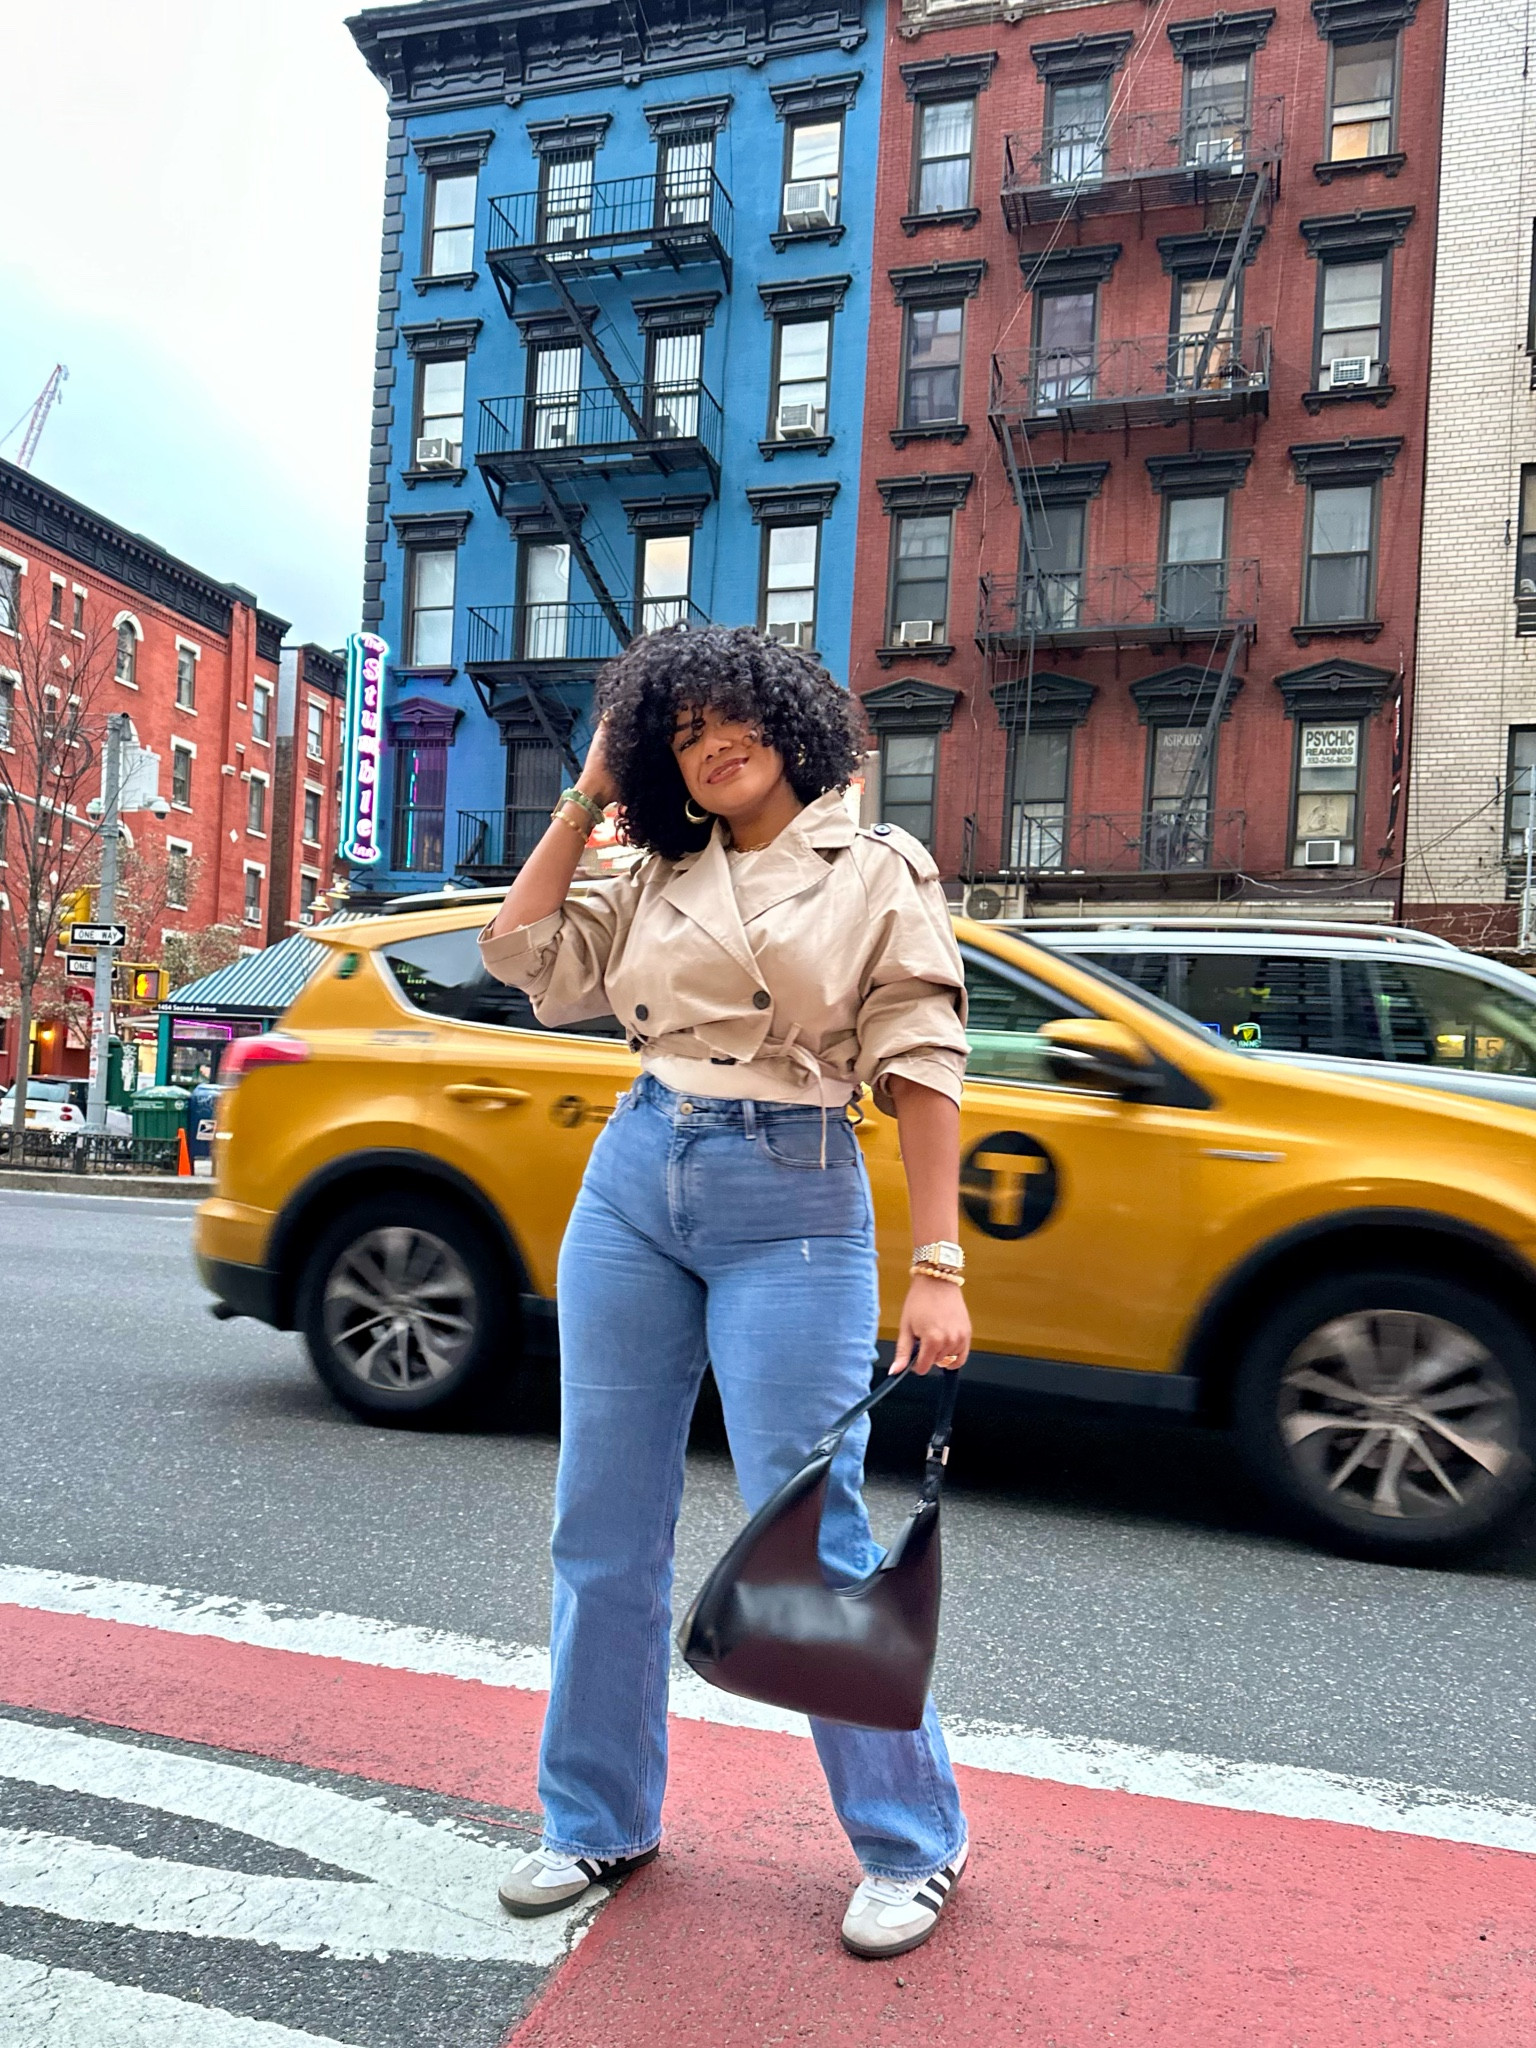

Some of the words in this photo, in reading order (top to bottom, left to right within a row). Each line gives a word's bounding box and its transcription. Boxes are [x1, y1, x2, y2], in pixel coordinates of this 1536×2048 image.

[1305, 730, 1355, 747] PSYCHIC
[1305, 747, 1354, 756] READINGS
[78, 930, 95, 940] ONE
[101, 931, 118, 941] WAY
[74, 961, 90, 972] ONE
[173, 1004, 194, 1012] Second
[195, 1005, 217, 1013] Avenue
[973, 1151, 1049, 1226] T
